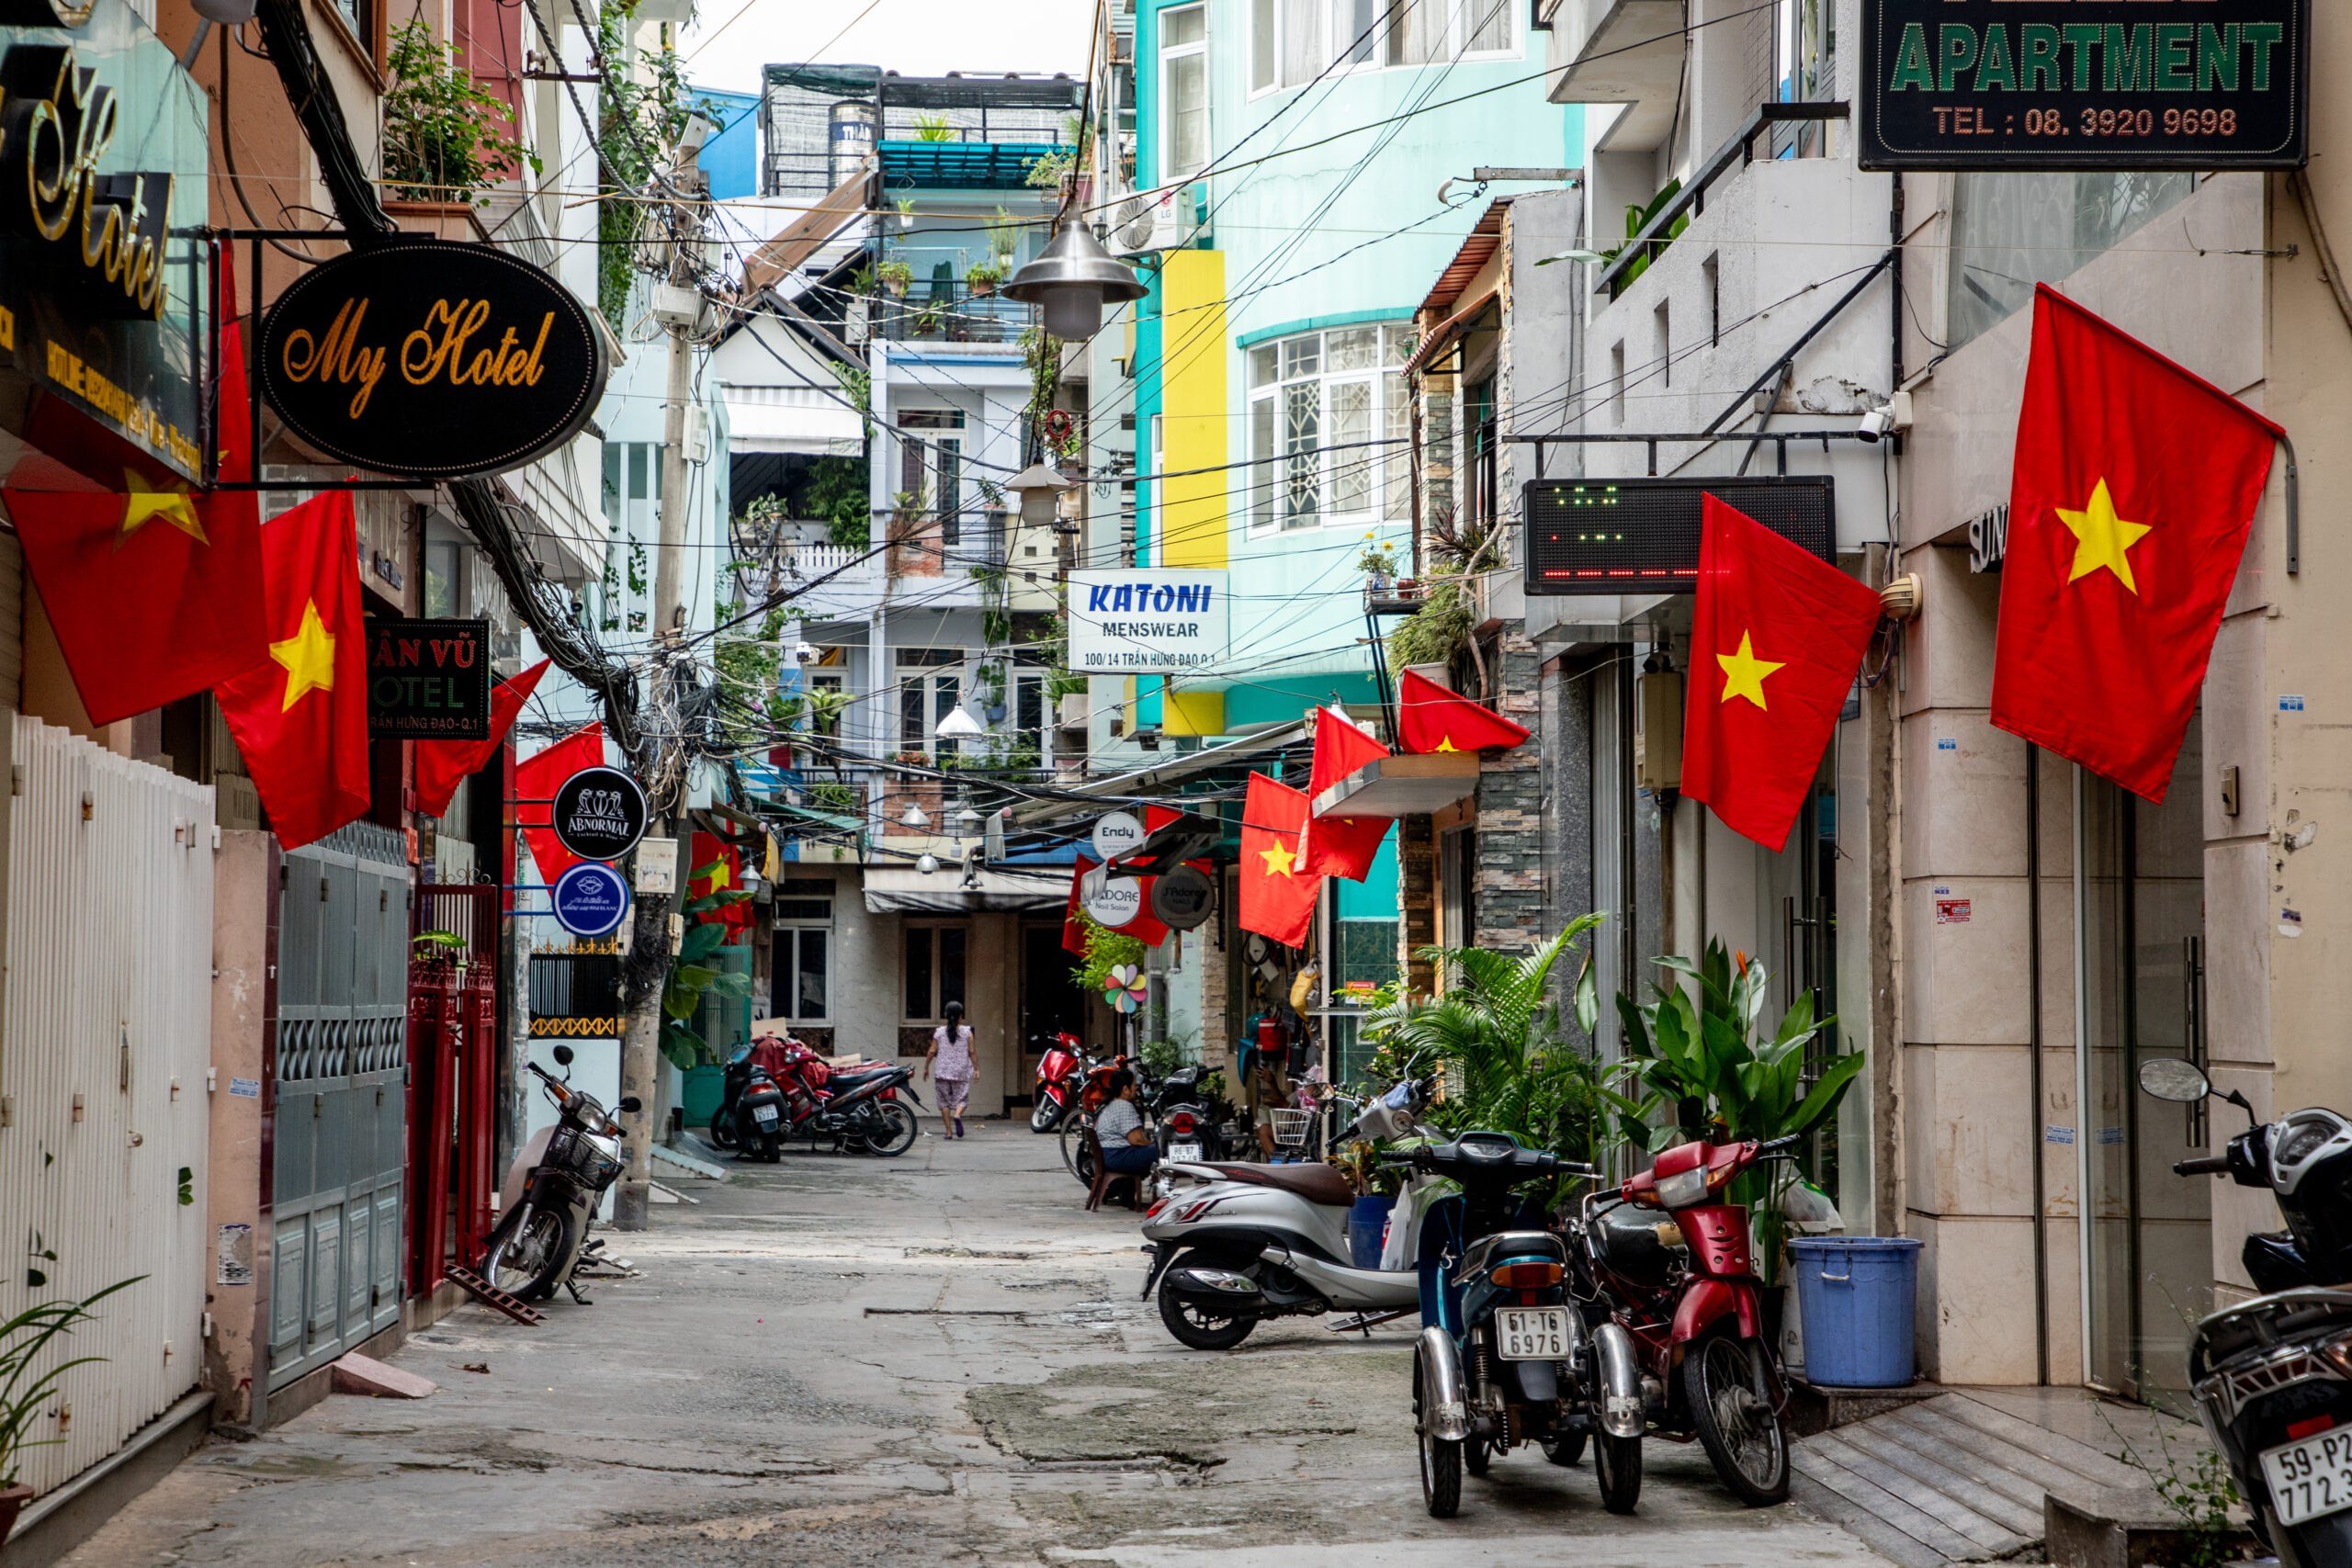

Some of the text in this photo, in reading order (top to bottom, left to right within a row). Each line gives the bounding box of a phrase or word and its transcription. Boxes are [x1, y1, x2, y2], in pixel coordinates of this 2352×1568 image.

[1890, 22, 2284, 92] APARTMENT
[1933, 107, 1995, 135] TEL
[2024, 108, 2070, 136] 08.
[2080, 108, 2154, 136] 3920
[2163, 108, 2238, 136] 9698
[1160, 209, 1171, 219] LG
[283, 298, 555, 419] My Hotel
[1969, 503, 2009, 573] SUN
[1089, 584, 1212, 613] KATONI
[1102, 622, 1199, 637] MENSWEAR
[429, 632, 477, 669] VŨ
[1085, 653, 1119, 666] 100/14
[372, 676, 465, 707] OTEL
[369, 711, 393, 728] RẦN
[568, 817, 630, 837] ABNORMAL
[1102, 827, 1135, 839] Endy
[1110, 902, 1130, 912] Salon
[1509, 1312, 1559, 1333] 51-T6
[1510, 1334, 1560, 1355] 6976
[2278, 1433, 2352, 1482] 59-P2
